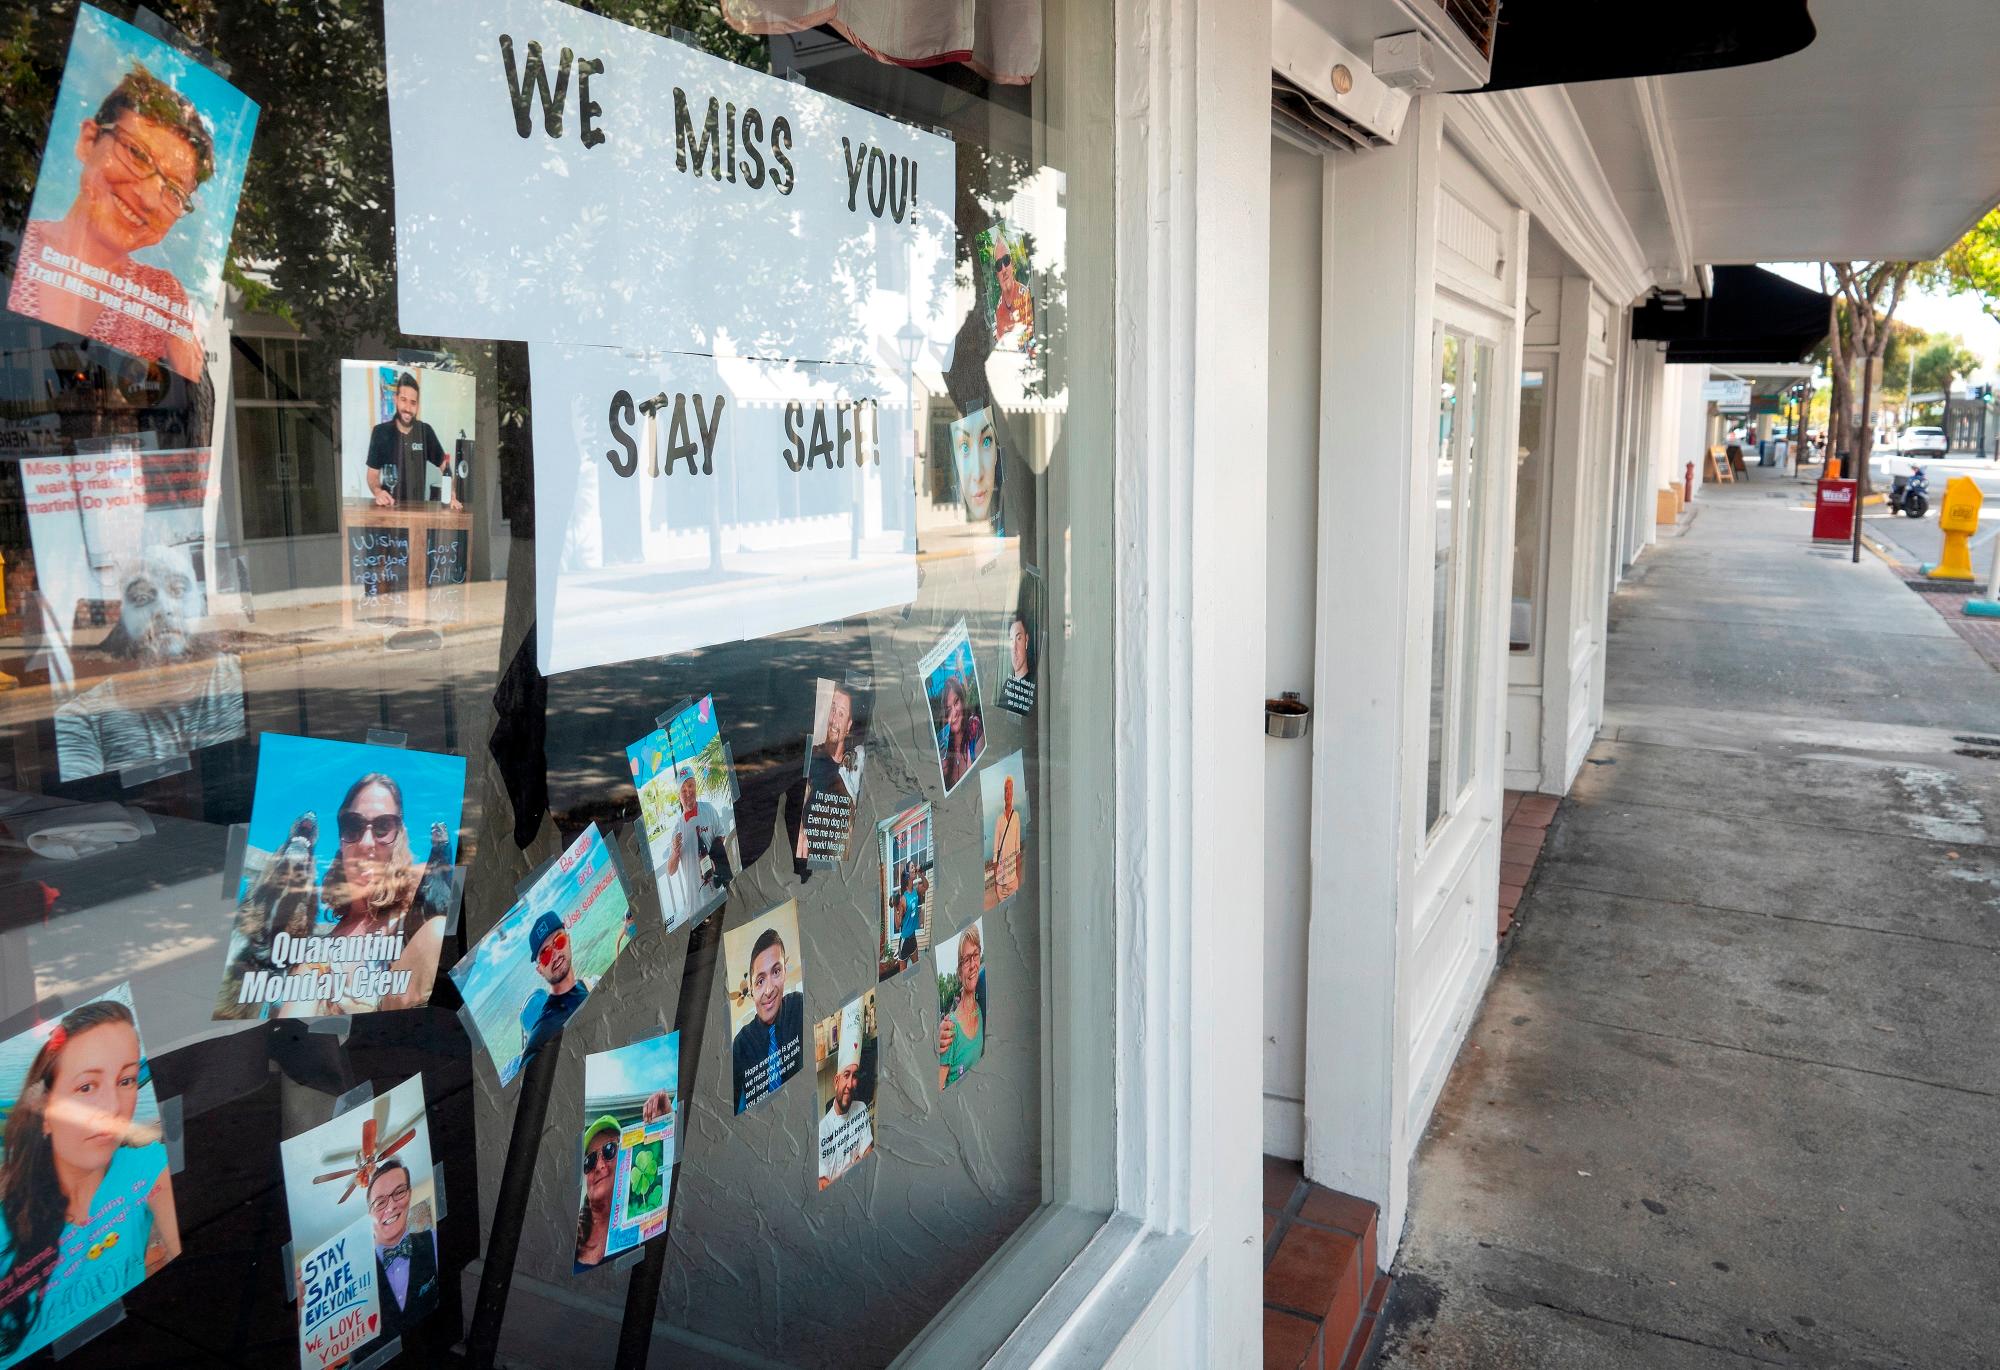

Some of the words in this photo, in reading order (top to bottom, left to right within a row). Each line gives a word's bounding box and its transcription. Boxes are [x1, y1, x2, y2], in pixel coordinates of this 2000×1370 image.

[499, 33, 605, 150] WE
[673, 86, 795, 196] MISS
[842, 135, 918, 226] YOU!
[42, 247, 79, 272] Can't
[80, 259, 109, 285] wait
[110, 272, 123, 289] to
[125, 277, 142, 297] be
[142, 284, 170, 309] back
[64, 274, 97, 300] Miss
[98, 290, 122, 312] you
[144, 307, 169, 332] Stay
[606, 389, 726, 479] STAY
[26, 462, 61, 476] Miss
[67, 462, 91, 477] you
[36, 481, 67, 494] wait
[83, 496, 100, 509] Do
[105, 495, 129, 510] you
[824, 793, 838, 805] going
[808, 814, 822, 824] Even
[832, 817, 841, 828] dog
[271, 931, 405, 968] Quarantini
[238, 969, 348, 1004] Monday
[350, 964, 413, 999] Crew
[821, 1131, 835, 1148] God
[821, 1143, 837, 1160] Stay
[304, 1238, 347, 1286] STAY
[304, 1270, 372, 1328] EVEYONE!!!
[306, 1261, 353, 1309] SAFE
[305, 1333, 324, 1354] WE
[329, 1307, 364, 1342] LOVE
[319, 1322, 367, 1365] YOU!!!
